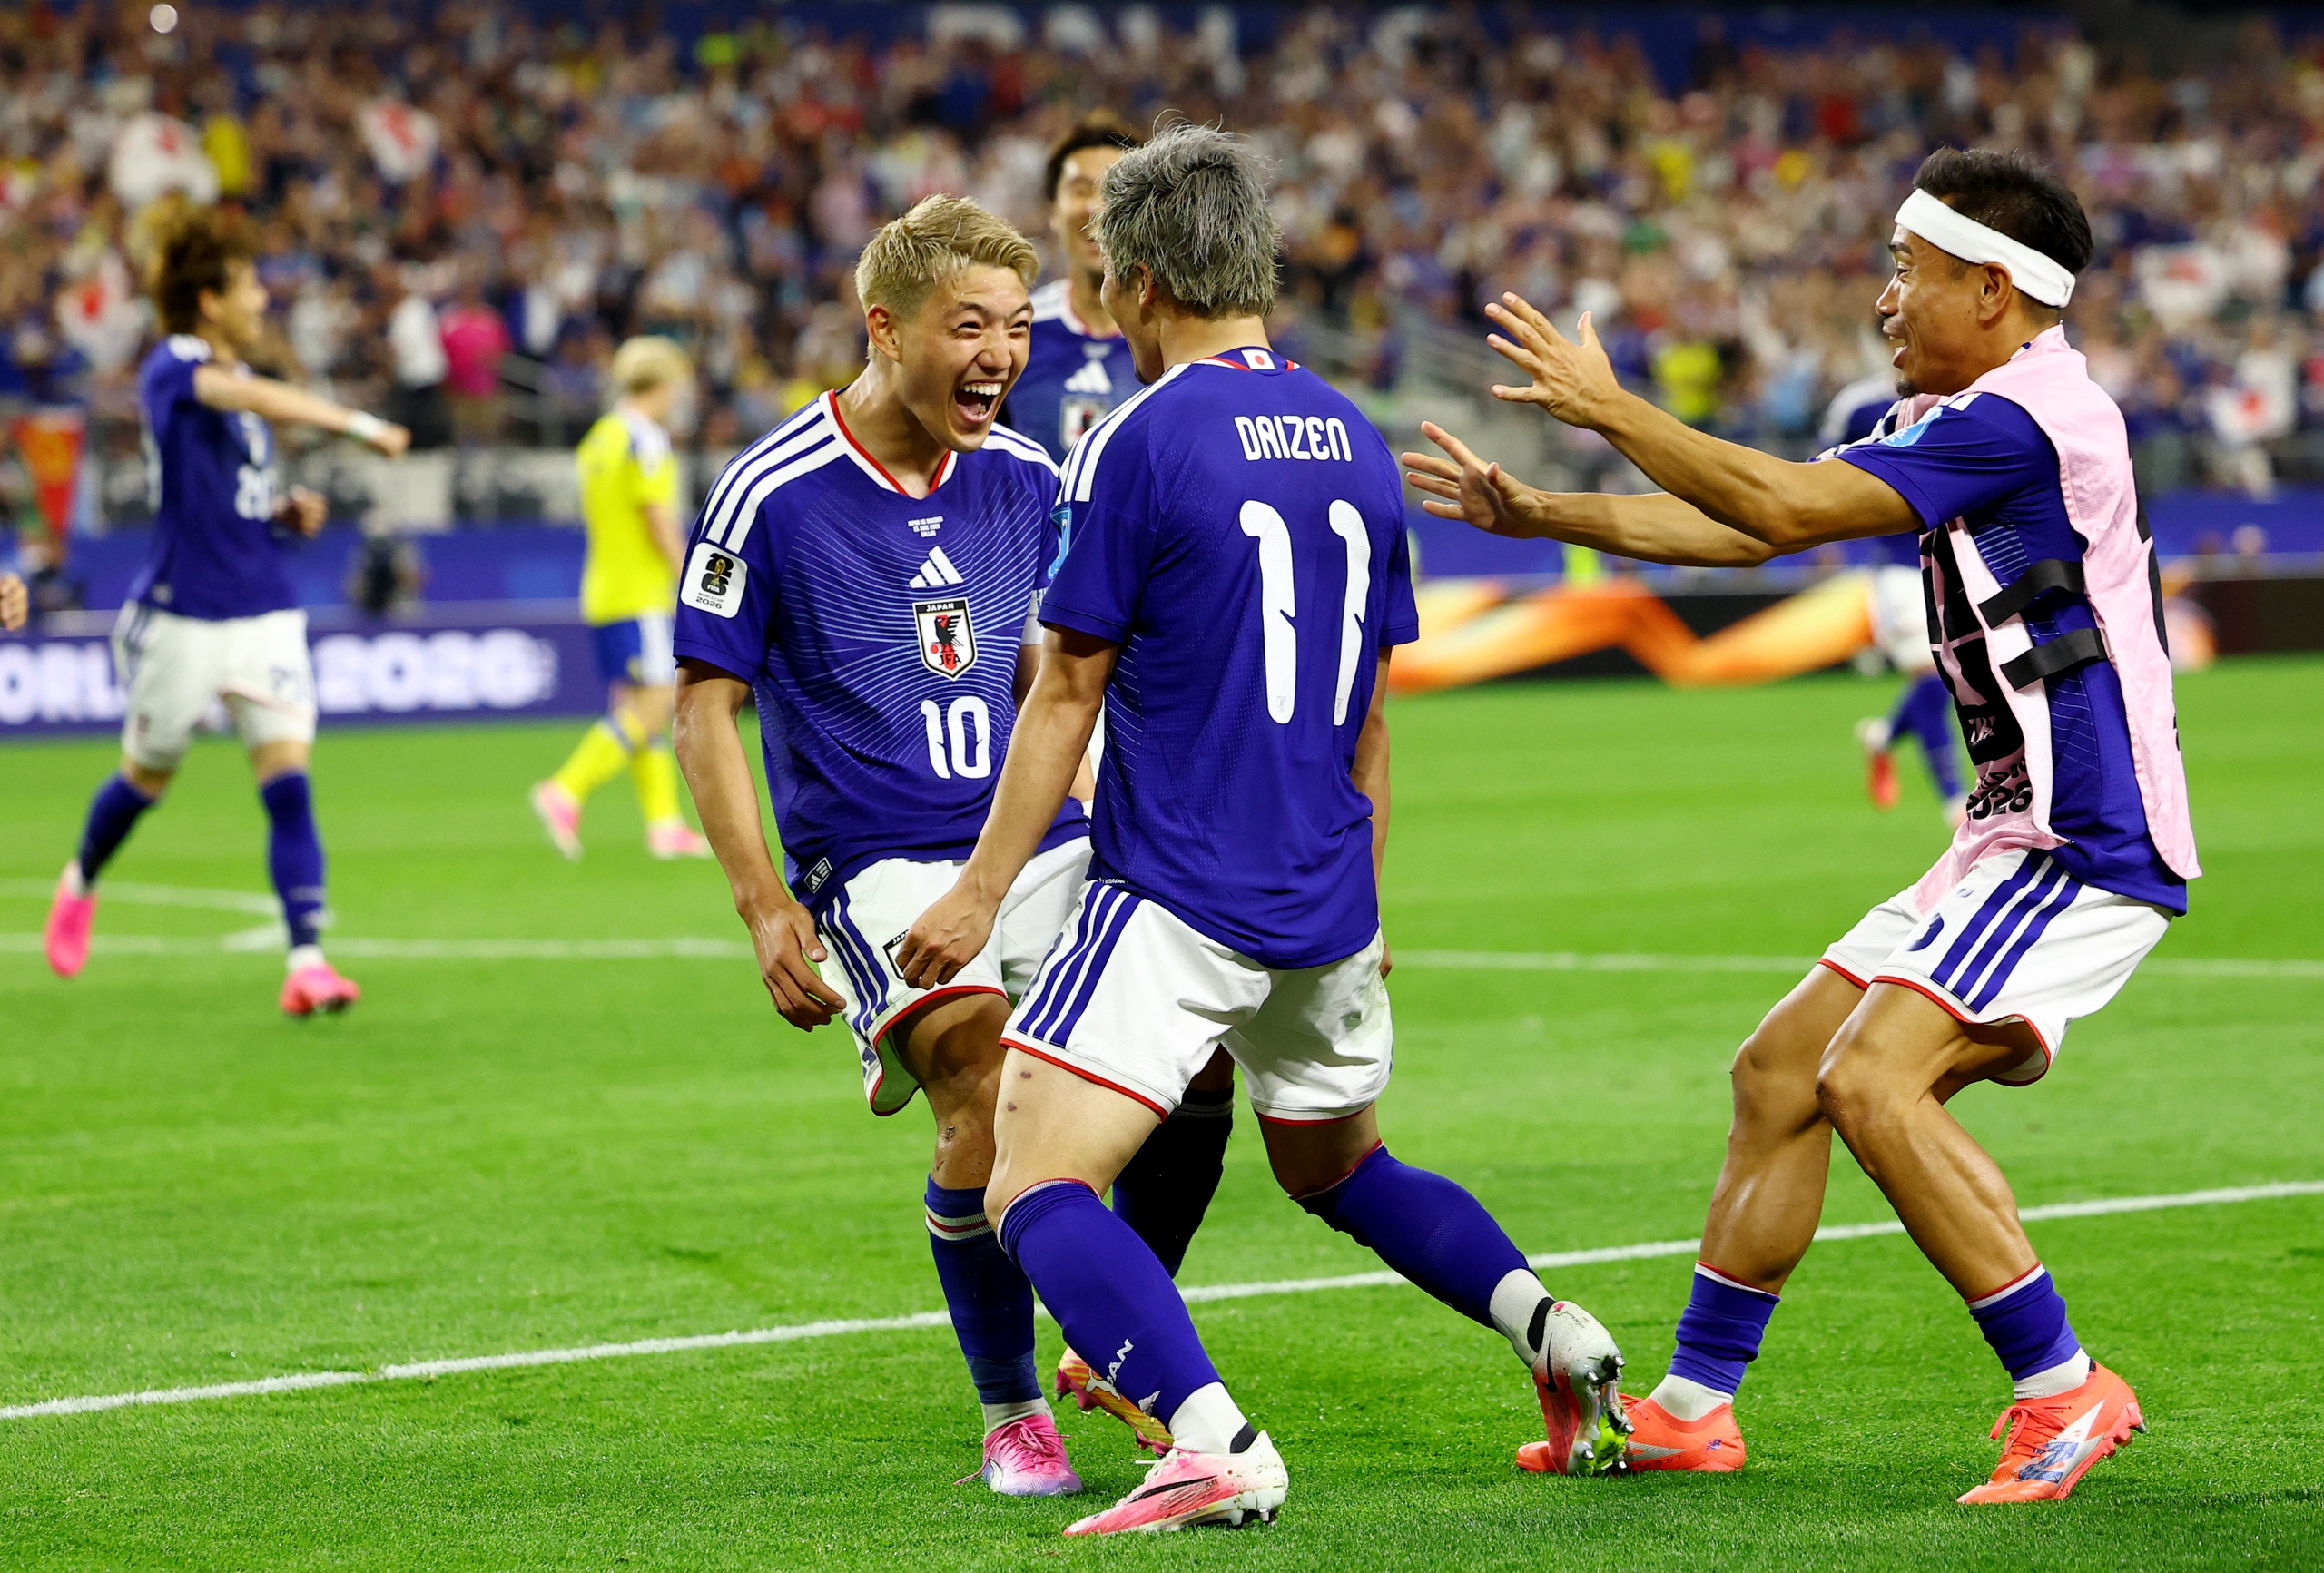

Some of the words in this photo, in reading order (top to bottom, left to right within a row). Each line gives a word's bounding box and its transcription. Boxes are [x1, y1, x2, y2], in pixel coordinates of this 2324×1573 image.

[1234, 415, 1353, 462] DAIZEN
[706, 584, 721, 593] FIFA
[695, 596, 723, 609] 2026
[926, 603, 955, 612] JAPAN
[1238, 499, 1372, 726] 11
[939, 654, 962, 665] JFA
[920, 695, 992, 780] 10
[892, 932, 906, 945] JAP
[1107, 1338, 1134, 1390] PAN
